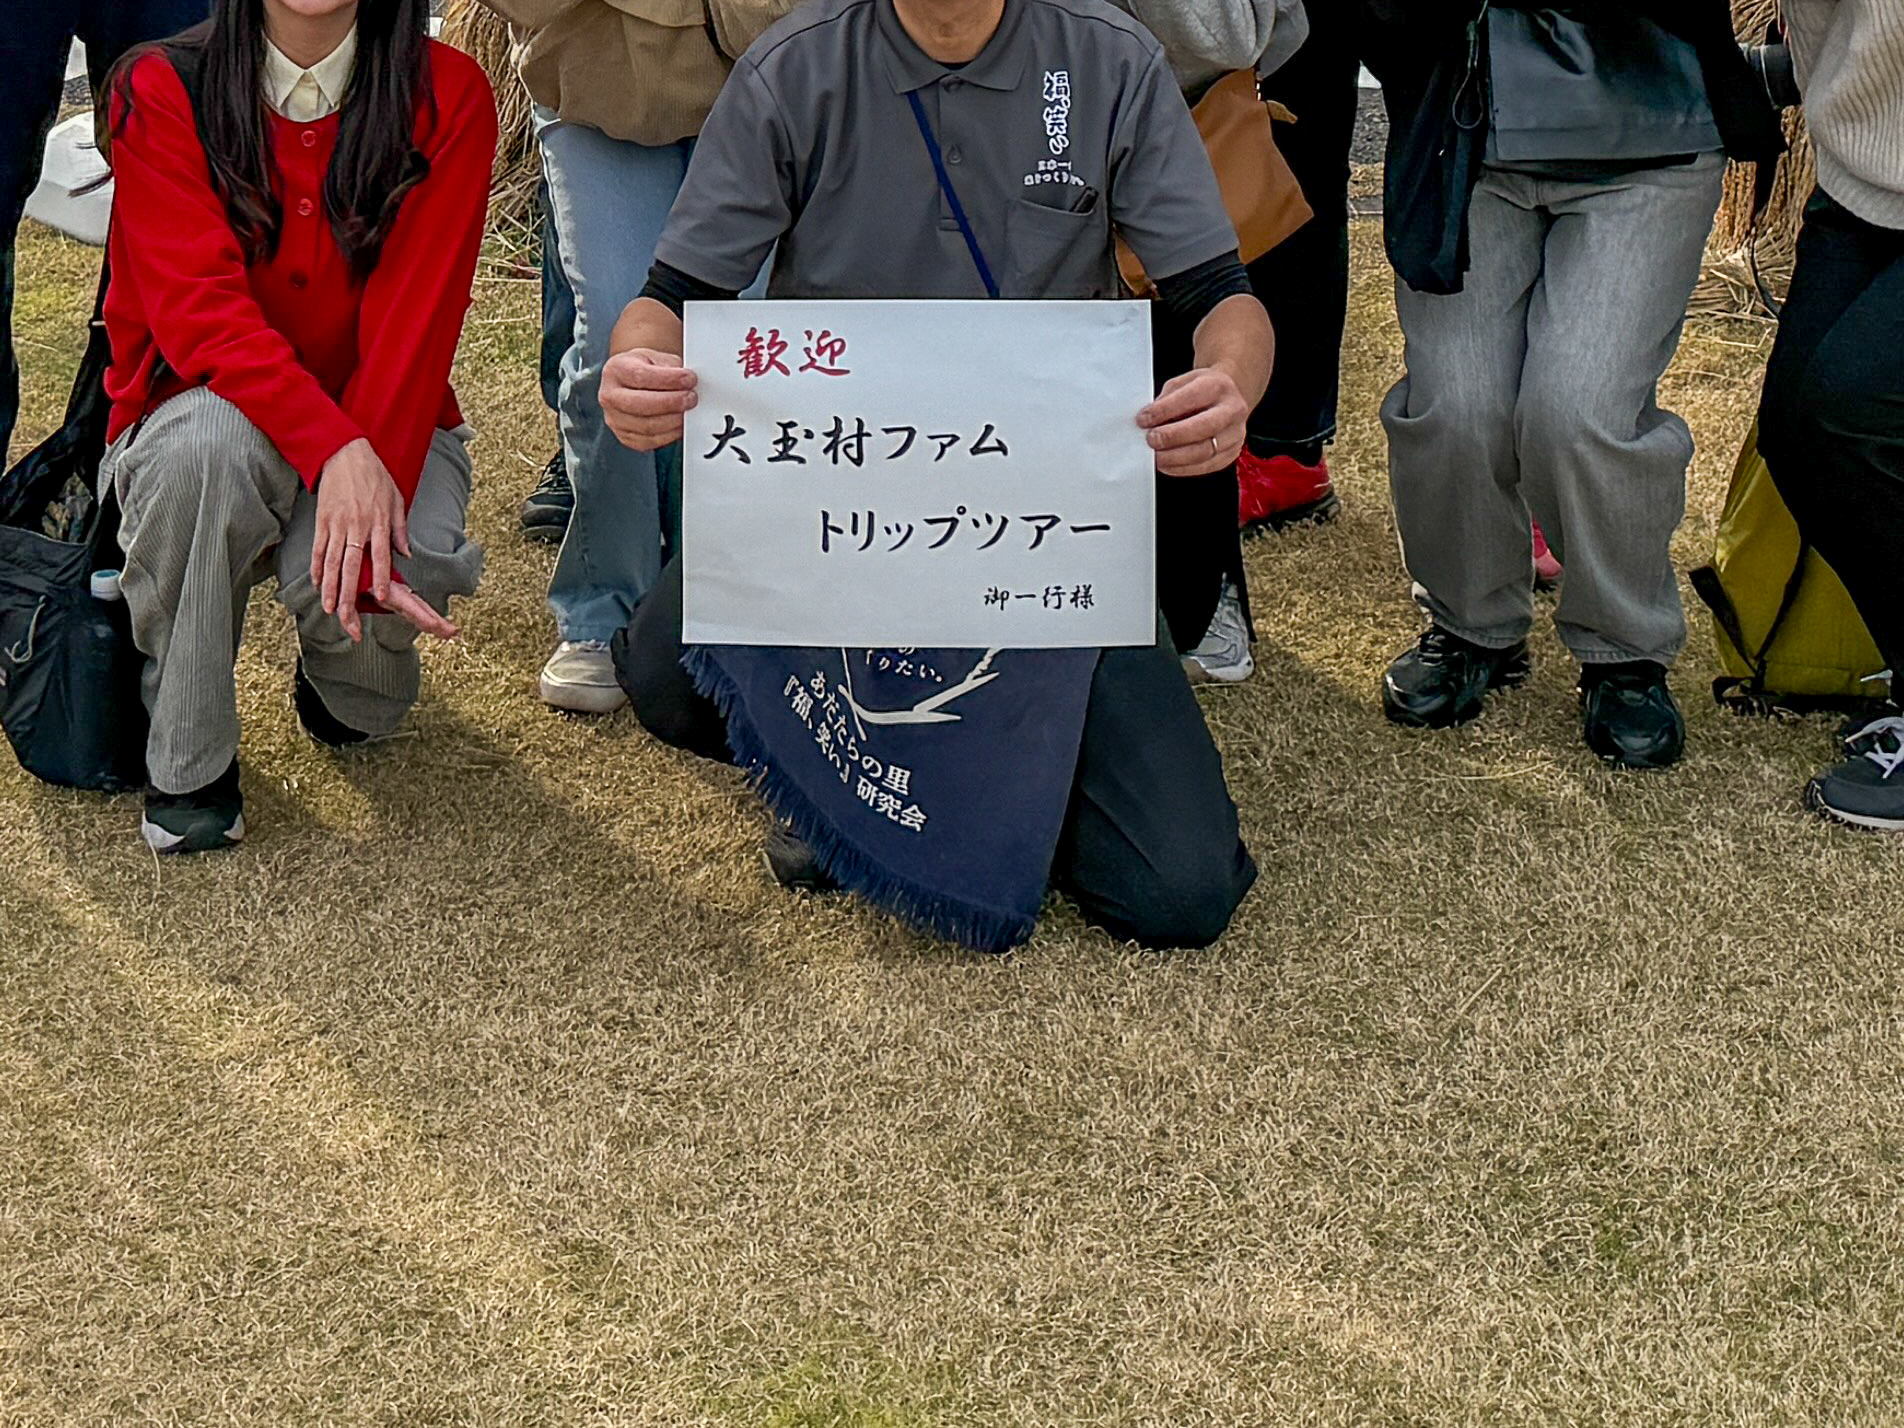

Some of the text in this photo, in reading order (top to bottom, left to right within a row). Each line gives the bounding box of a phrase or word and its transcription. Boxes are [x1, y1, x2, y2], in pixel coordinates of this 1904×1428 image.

[736, 327, 851, 379] 歓迎
[702, 414, 1010, 468] 大玉村ファム
[820, 505, 1112, 554] トリップツアー
[983, 583, 1096, 612] 御一行様
[810, 671, 912, 796] あだたらの里
